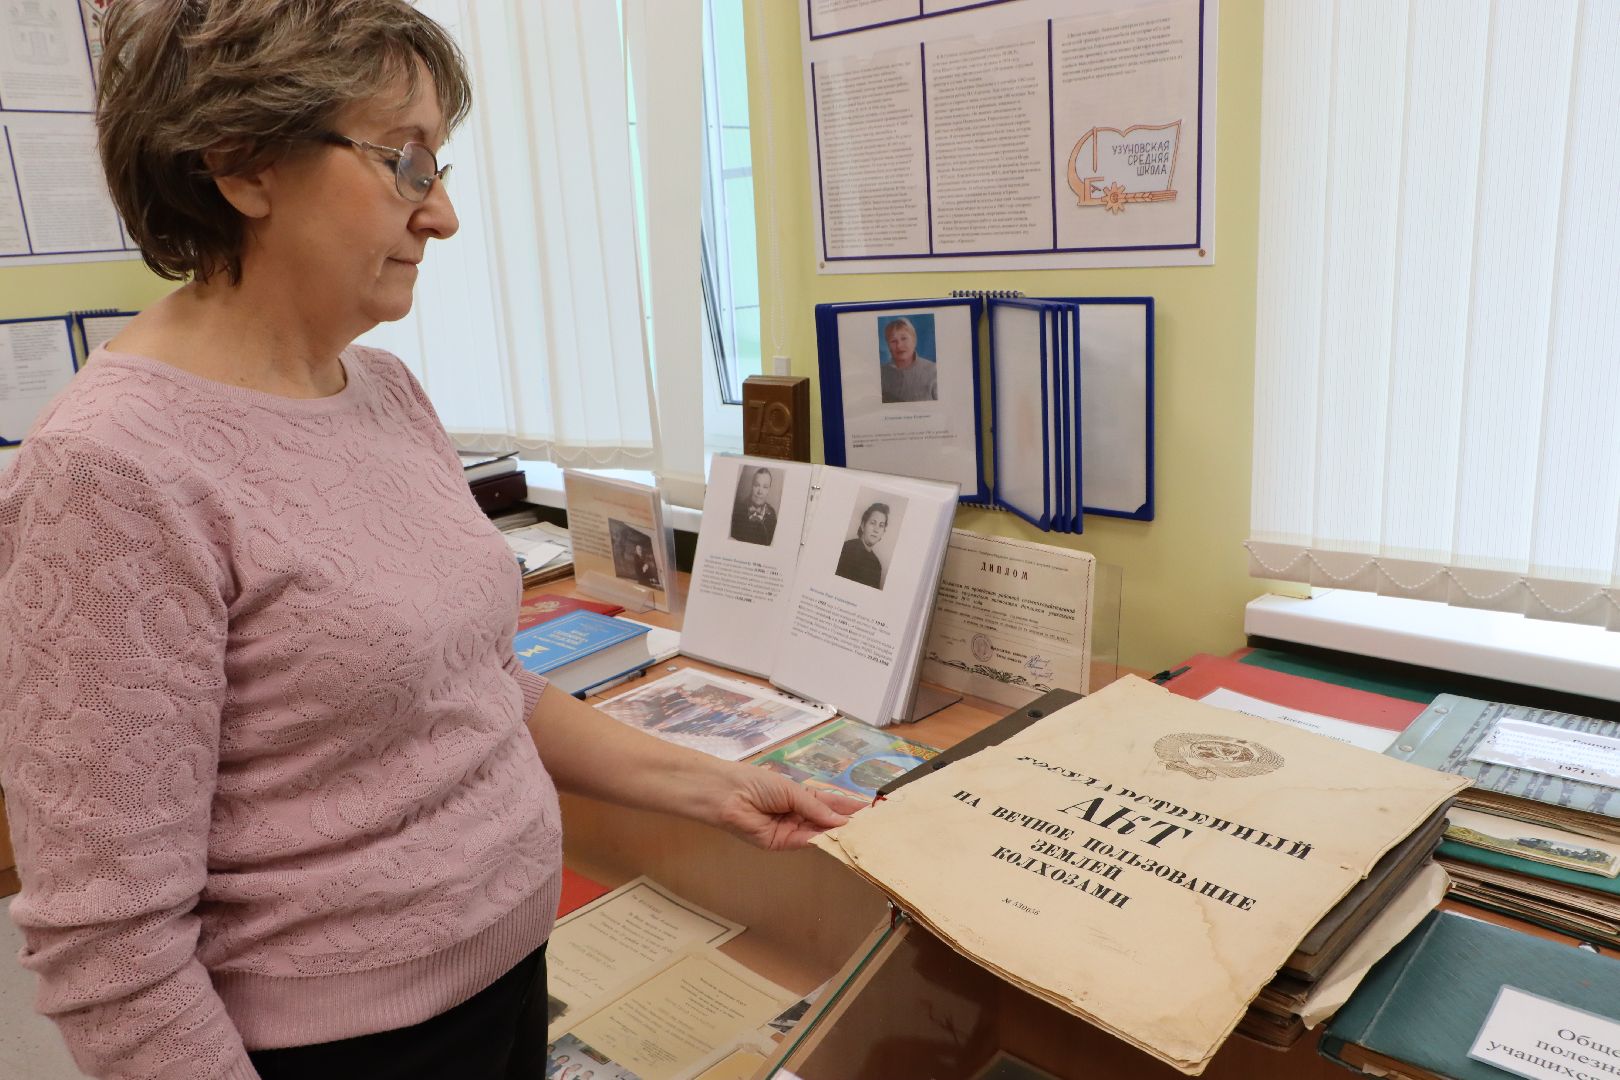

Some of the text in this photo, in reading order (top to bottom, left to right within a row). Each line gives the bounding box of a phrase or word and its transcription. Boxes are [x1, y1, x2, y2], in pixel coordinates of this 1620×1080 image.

[1111, 140, 1170, 155] УЗУНОВСКАЯ
[1127, 152, 1169, 166] СРЕДНЯЯ
[1136, 164, 1167, 177] ШКОЛА
[980, 561, 1029, 581] ДИПЛОМ
[1016, 755, 1315, 860] ГОСУДАРСТВЕННЫЙ
[1056, 797, 1194, 848] АКТ
[952, 789, 1257, 912] НА ВЕЧНОЕ ПОЛЬЗОВАНИЕ
[1030, 838, 1125, 882] ЗЕМЛЕЙ
[991, 845, 1132, 910] КОЛХОЗАМИ
